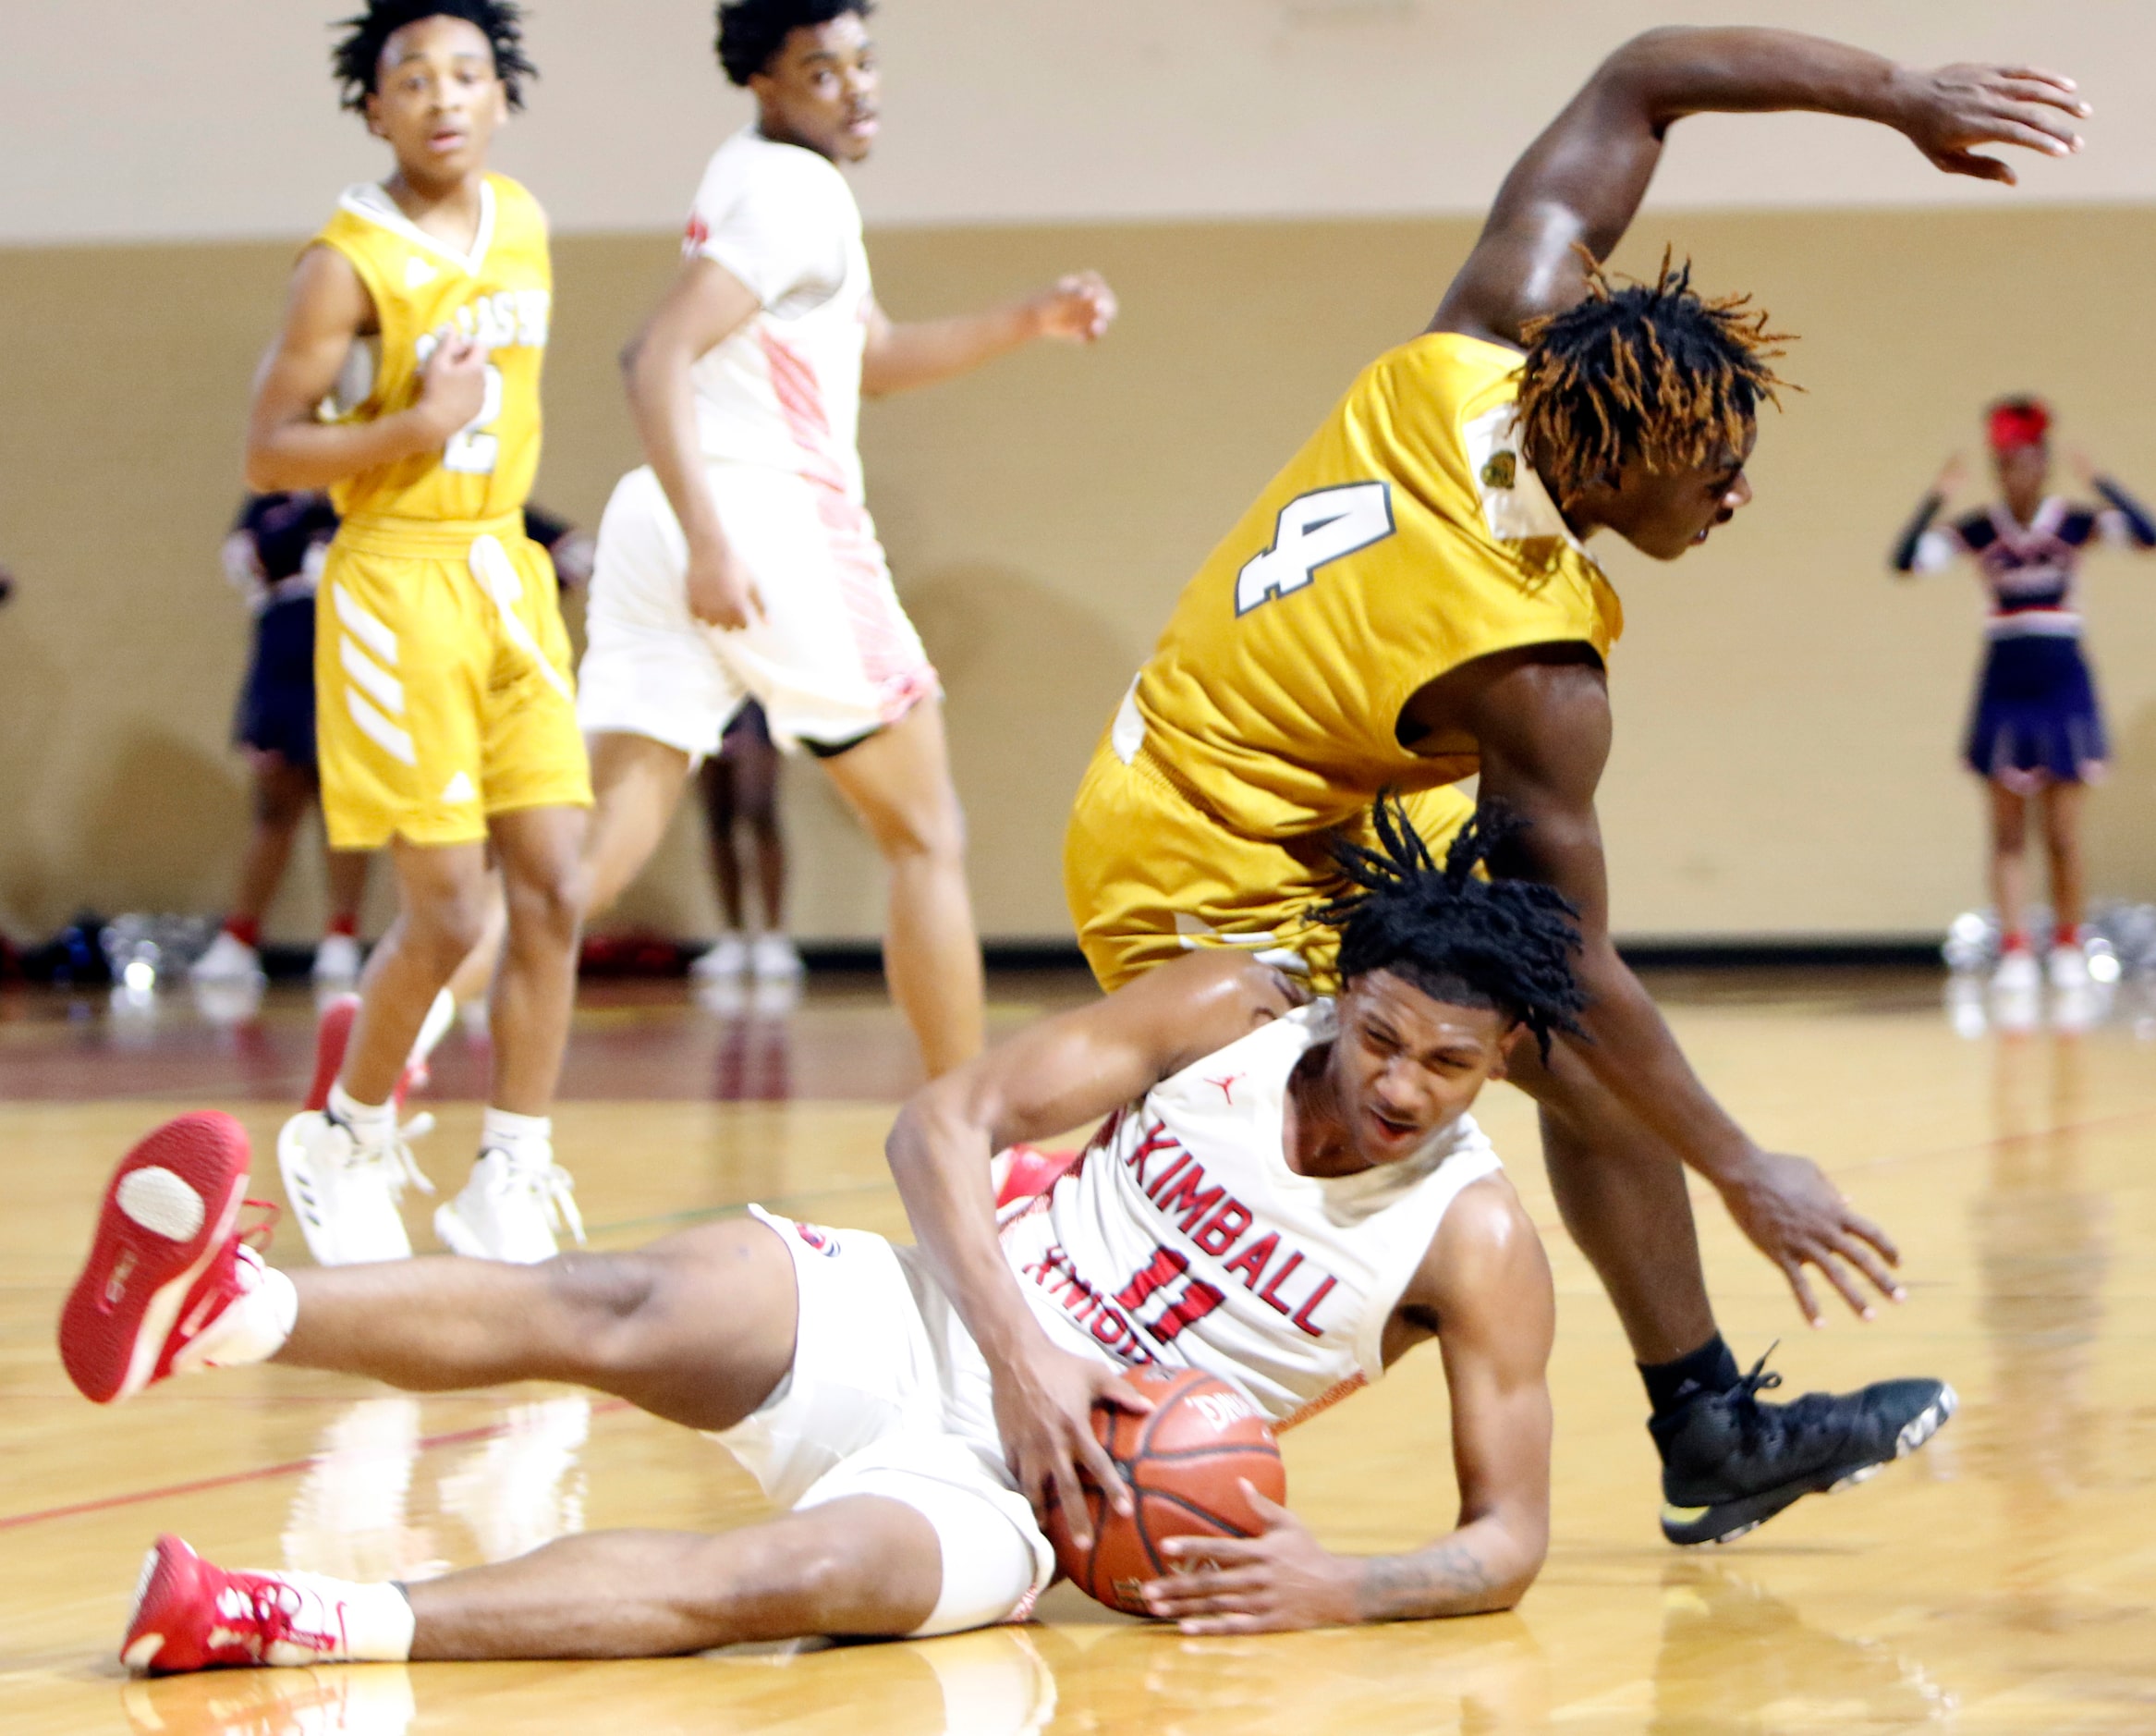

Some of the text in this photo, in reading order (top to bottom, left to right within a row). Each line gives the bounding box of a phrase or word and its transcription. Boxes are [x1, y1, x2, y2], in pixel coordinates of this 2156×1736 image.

[1234, 479, 1397, 618] 4
[1111, 1243, 1227, 1346] 11
[1125, 1119, 1338, 1338] KIMBALL
